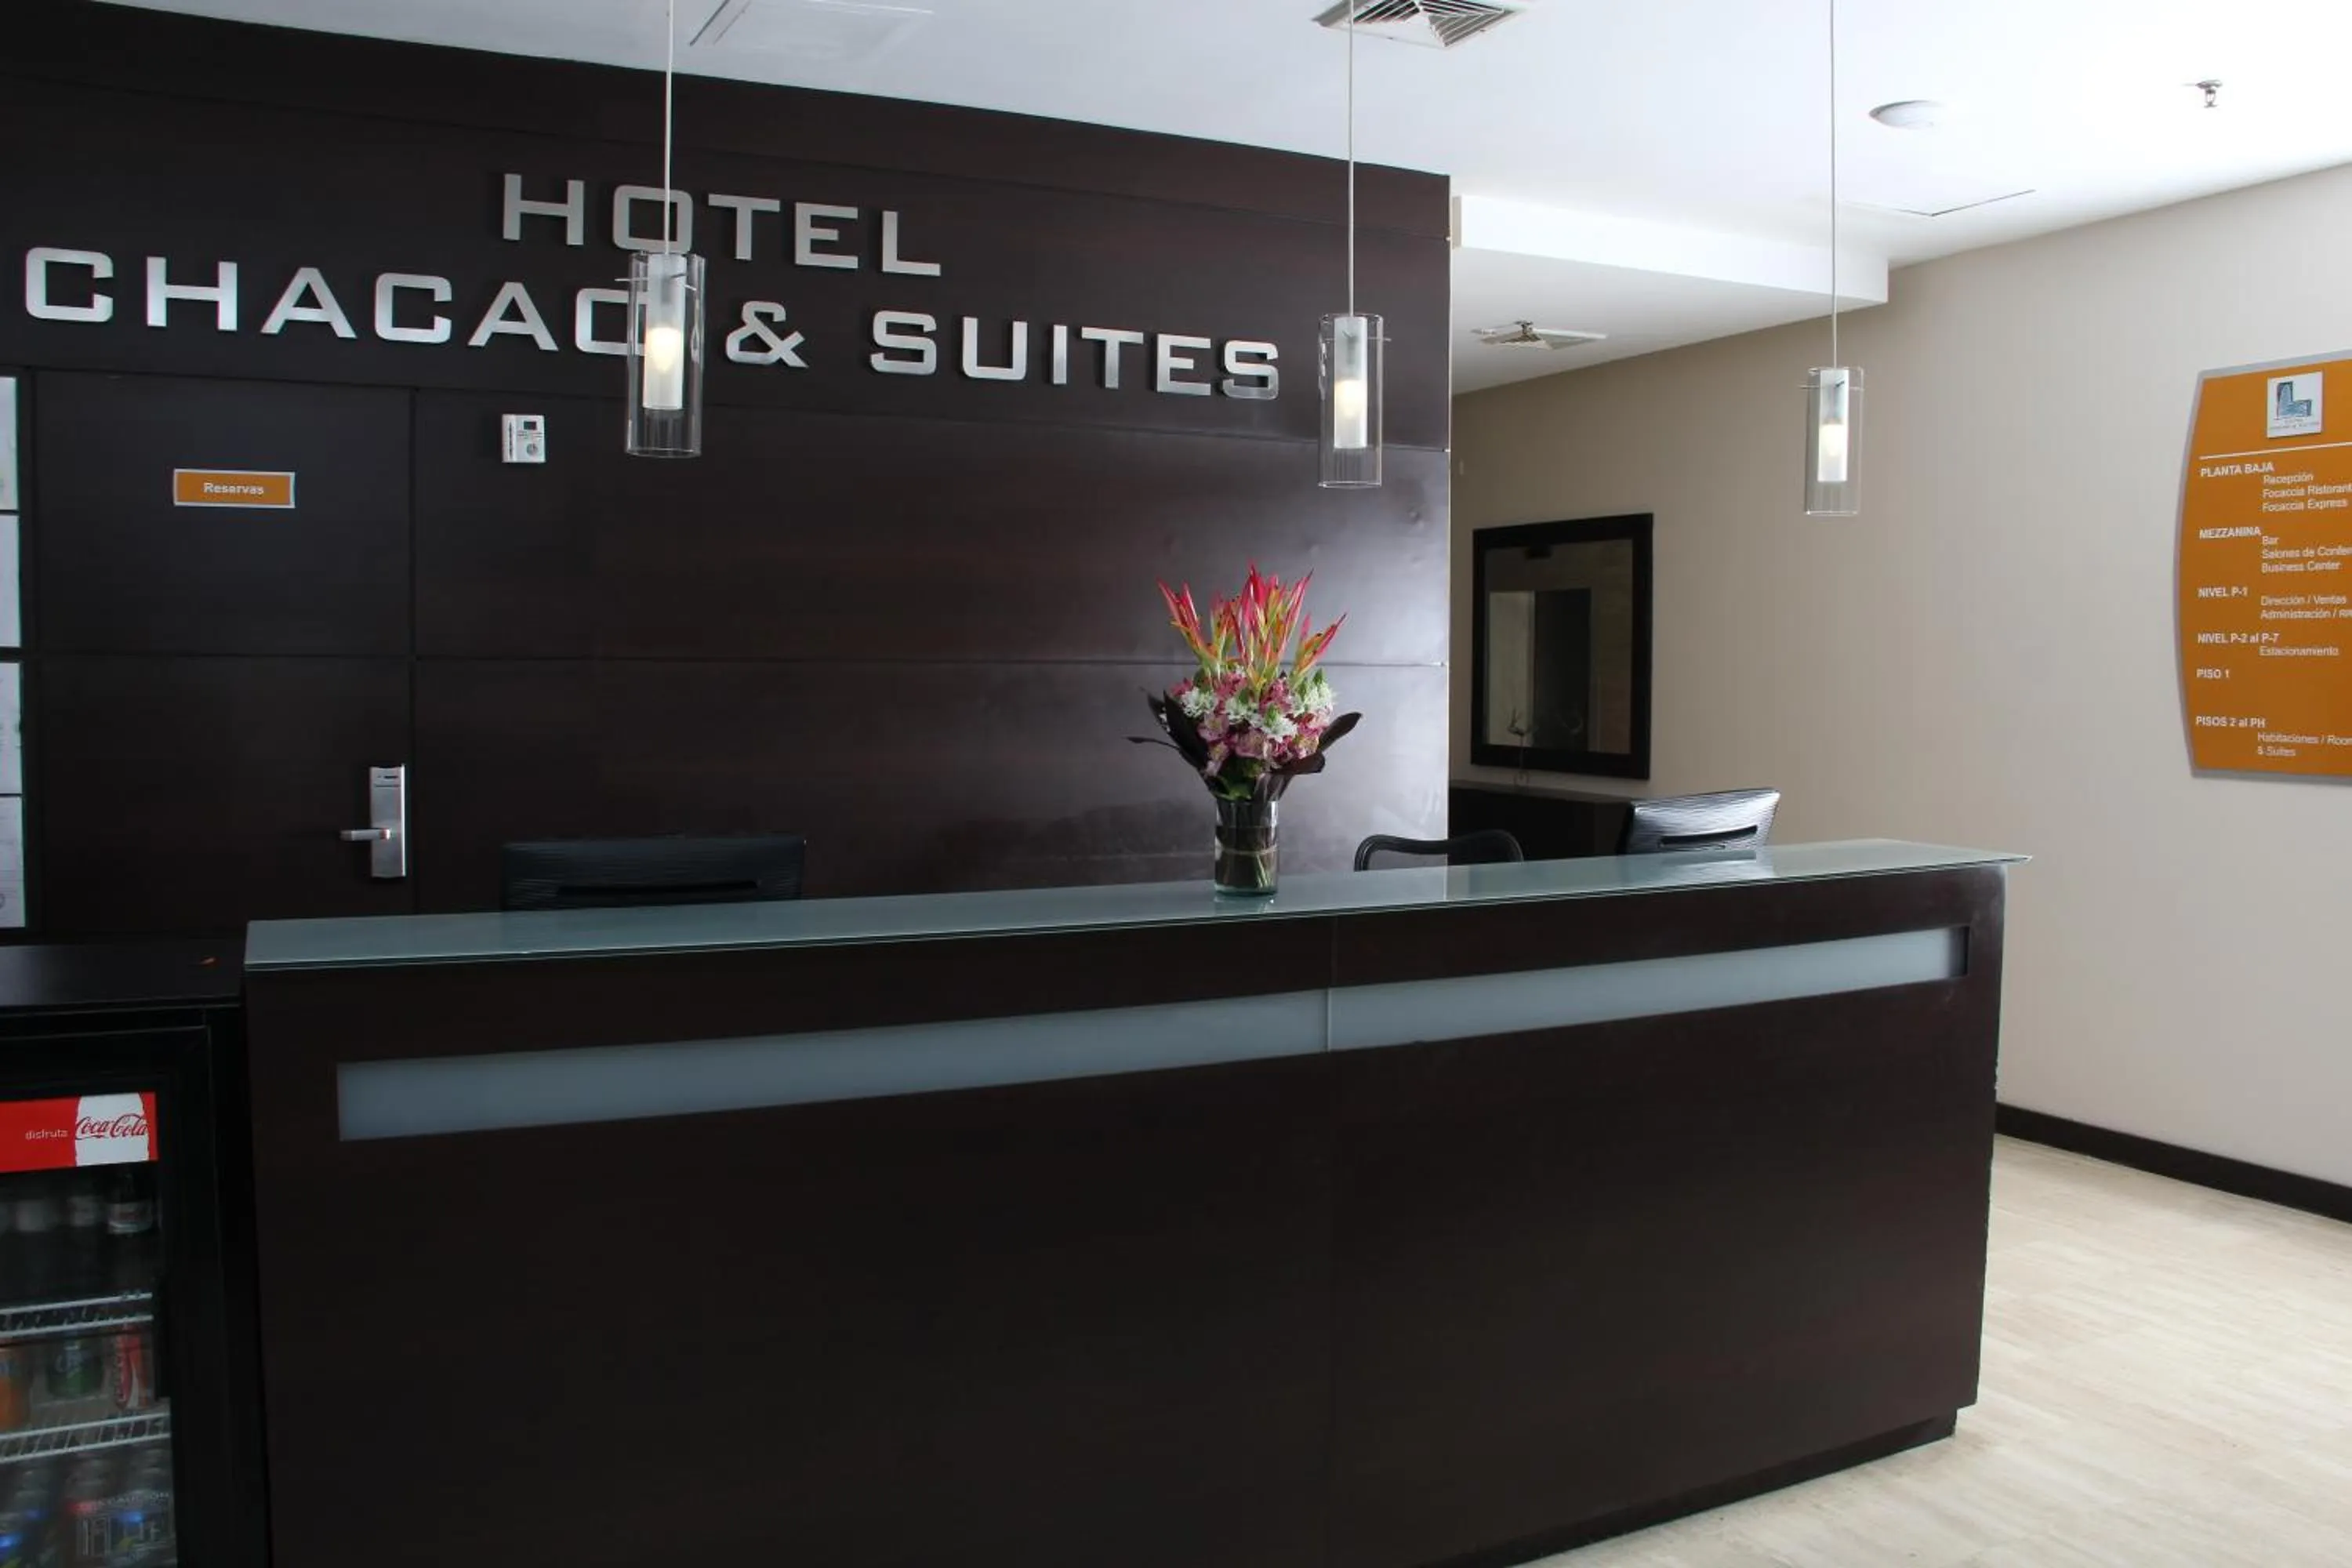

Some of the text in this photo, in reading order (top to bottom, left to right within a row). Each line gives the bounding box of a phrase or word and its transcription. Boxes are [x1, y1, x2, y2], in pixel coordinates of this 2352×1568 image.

[503, 173, 941, 277] HOTEL
[725, 300, 808, 368] &
[869, 310, 1279, 401] SUITES
[2201, 462, 2274, 477] PLANTA BAJA
[2263, 472, 2314, 485] Recepción
[203, 481, 264, 495] Reservas
[2307, 483, 2352, 495] Ristorant
[2307, 498, 2348, 510] Express
[2199, 526, 2261, 539] MEZZANINA
[2262, 535, 2279, 545] Bar
[2302, 547, 2315, 557] de
[2307, 560, 2340, 571] Center
[2198, 586, 2248, 598] NIVEL P-1
[2260, 594, 2305, 606] Dirección
[2314, 594, 2347, 604] Ventas
[2260, 608, 2331, 619] Administración
[2198, 633, 2280, 644] NIVEL P-2 al P-7
[2259, 645, 2339, 657] Estacionamiento
[2196, 668, 2222, 680] PISO
[2195, 715, 2227, 728] PISOS
[2238, 717, 2248, 728] al
[2250, 717, 2266, 728] PH
[2267, 746, 2296, 757] Suites
[25, 1113, 149, 1141] disfruta Coca-Cola
